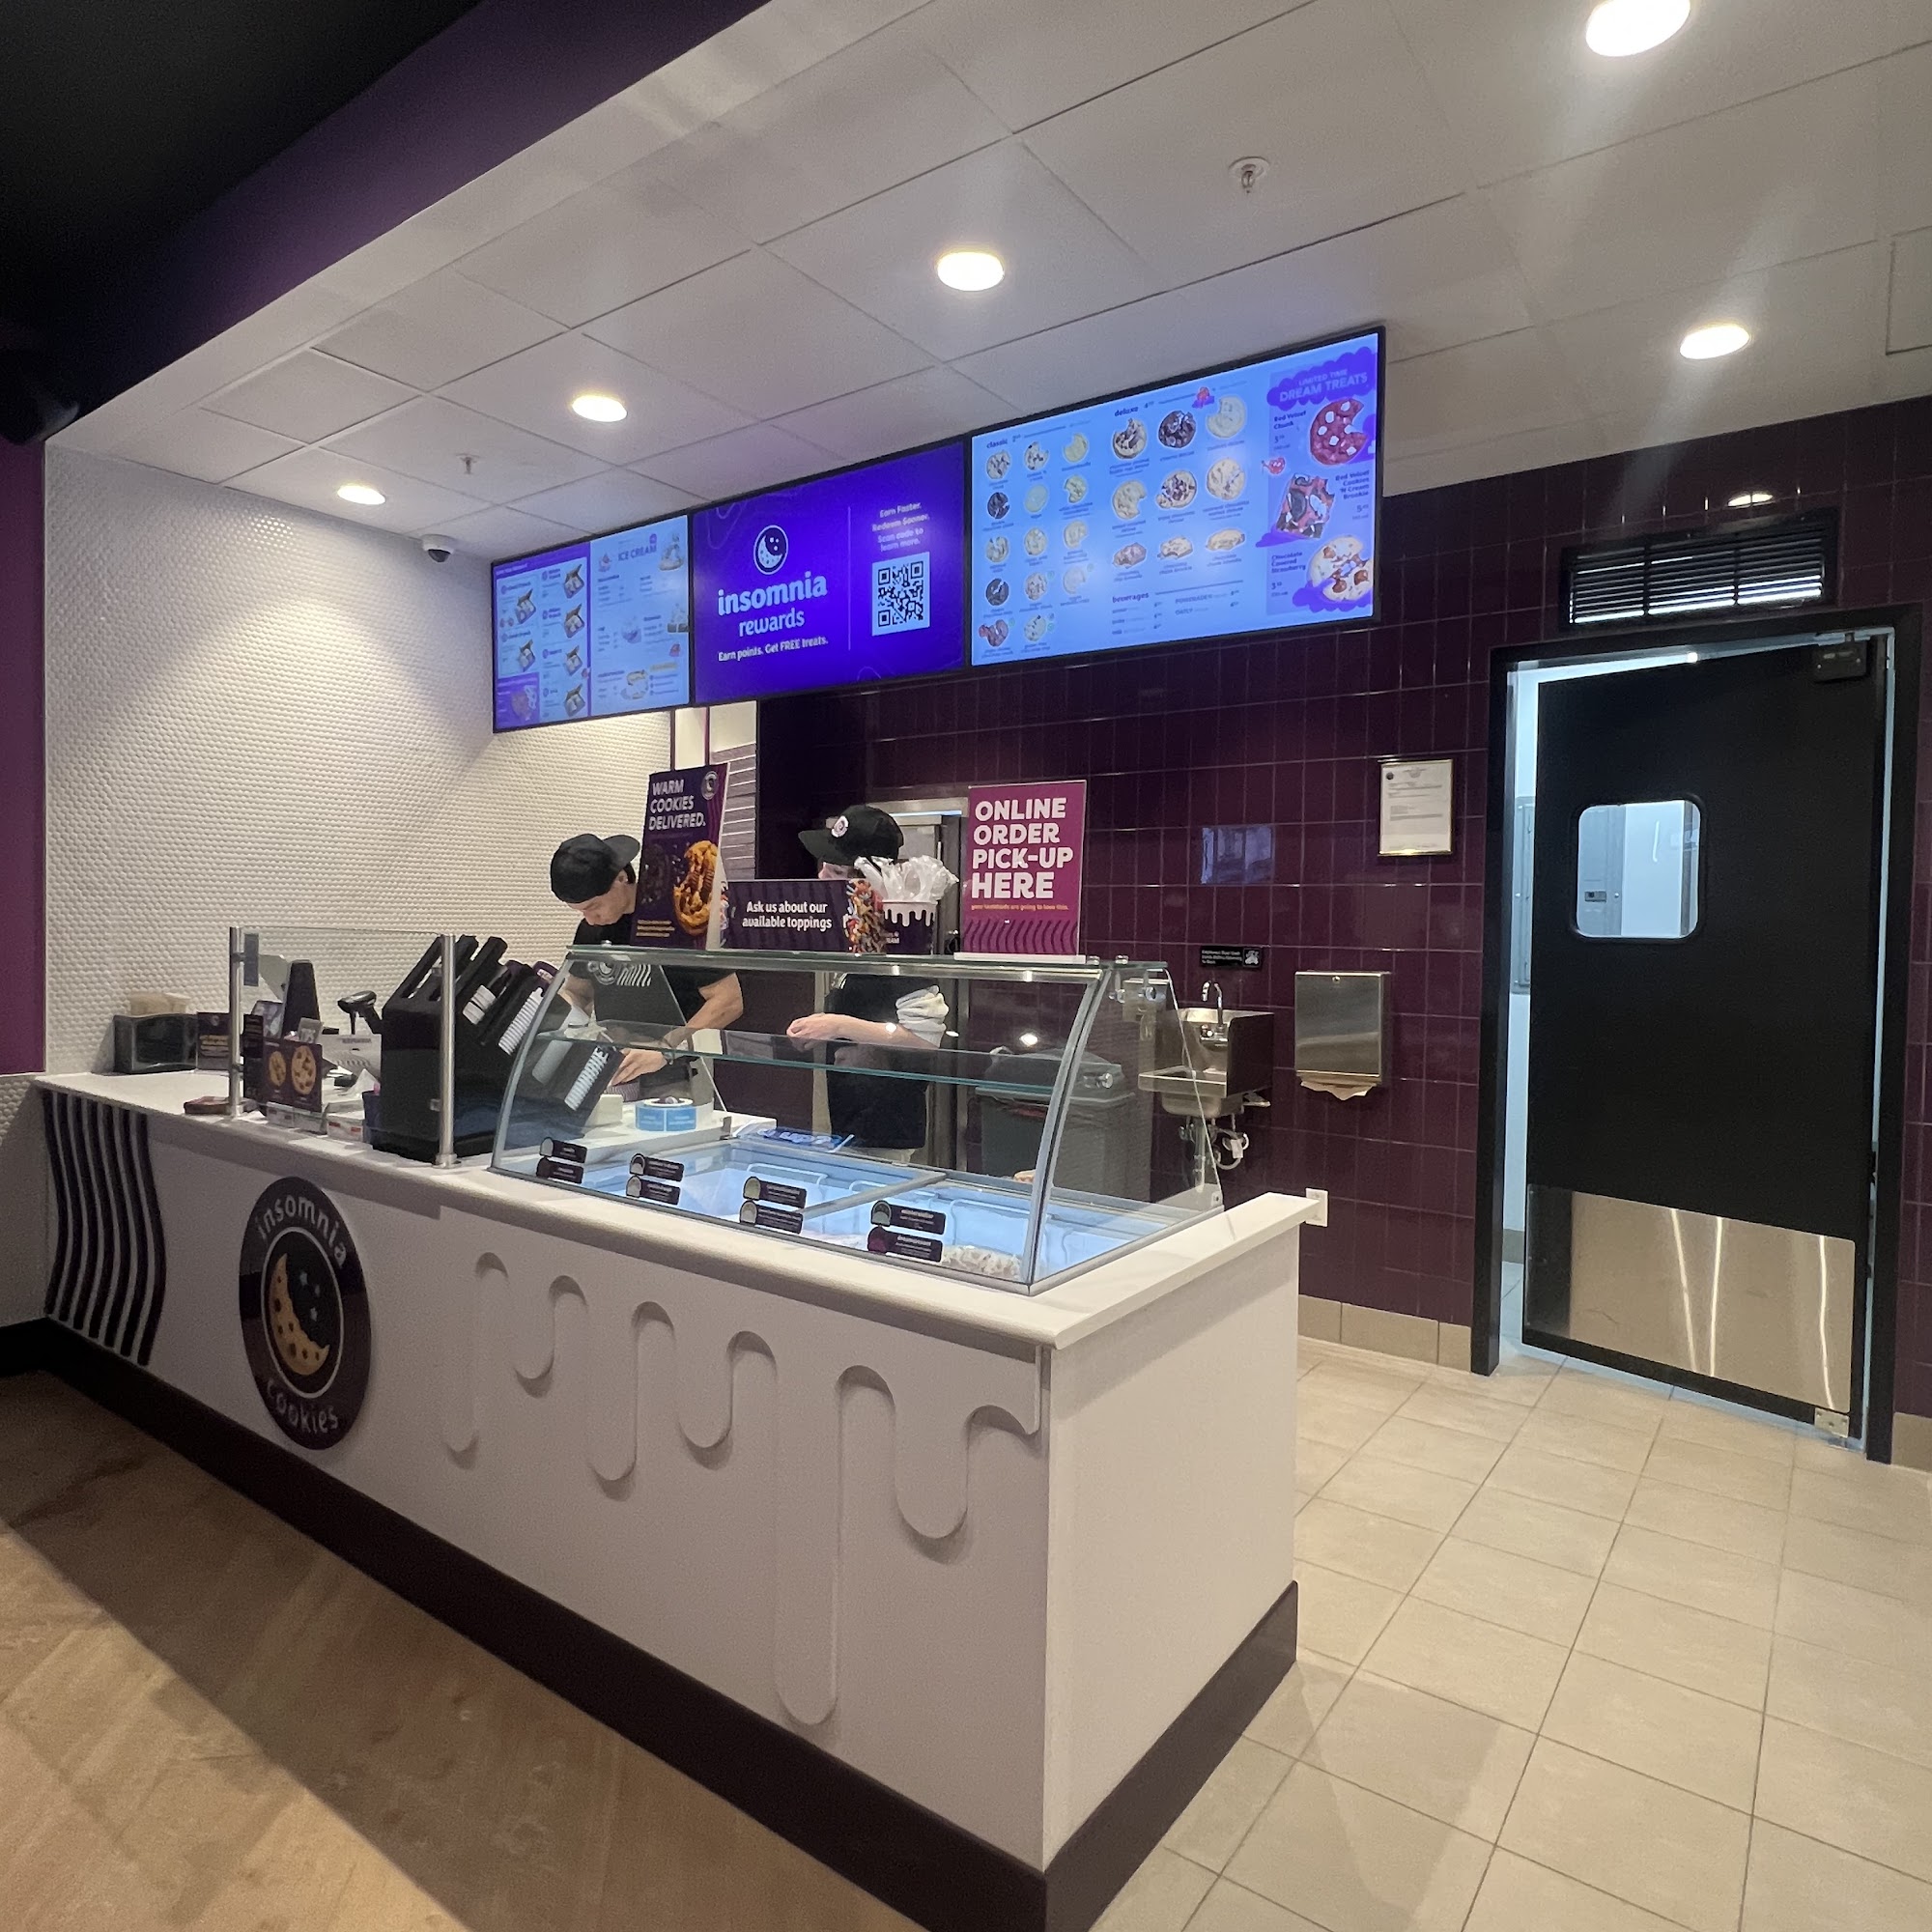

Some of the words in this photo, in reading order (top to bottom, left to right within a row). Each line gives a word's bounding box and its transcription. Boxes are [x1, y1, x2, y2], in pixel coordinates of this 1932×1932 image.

[1298, 374, 1328, 386] LIMITED
[1329, 369, 1348, 379] TIME
[1279, 383, 1322, 402] DREAM
[1325, 372, 1368, 390] TREATS
[1114, 407, 1138, 416] deluxe
[986, 439, 1008, 448] classic
[880, 509, 895, 518] Earn
[872, 521, 901, 531] Redeem
[878, 534, 895, 543] Scan
[618, 551, 629, 560] ICE
[631, 545, 657, 558] CREAM
[718, 571, 828, 616] insomnia
[1113, 592, 1150, 604] beverages
[739, 609, 805, 638] rewards
[718, 651, 737, 662] Earn
[737, 646, 764, 662] points.
[764, 643, 779, 654] Get
[780, 639, 801, 652] FREE
[802, 636, 829, 648] treats.
[652, 779, 685, 796] WARM
[650, 795, 695, 814] COOKIES
[975, 797, 1067, 822] ONLINE
[648, 812, 707, 831] DELIVERED.
[973, 822, 1061, 846] ORDER
[972, 846, 1074, 870] PICK-UP
[971, 871, 1055, 899] HERE
[746, 900, 764, 913] Ask
[765, 903, 777, 913] us
[778, 900, 809, 913] about
[809, 903, 828, 913] our
[742, 916, 786, 928] available
[786, 917, 833, 932] toppings
[254, 1194, 348, 1269] insomnia
